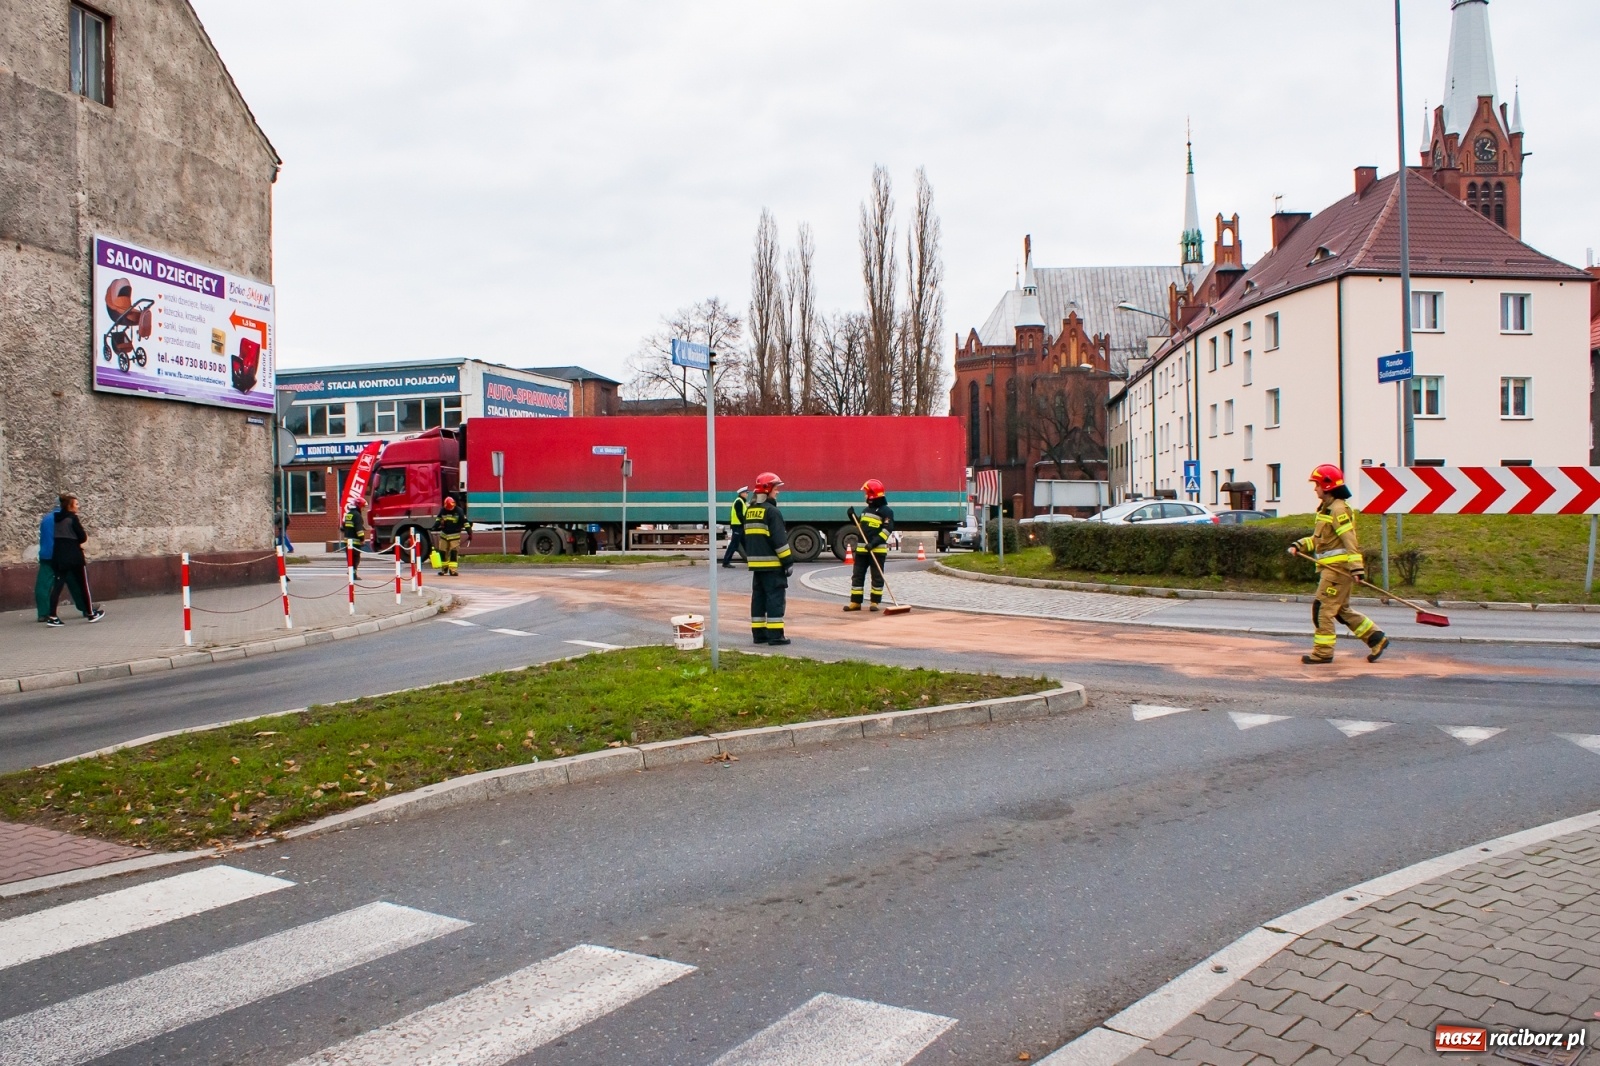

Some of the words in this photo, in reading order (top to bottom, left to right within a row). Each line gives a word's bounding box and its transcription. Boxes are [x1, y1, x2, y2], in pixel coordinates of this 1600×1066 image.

[106, 248, 152, 275] SALON
[157, 262, 218, 293] DZIECIĘCY
[157, 352, 170, 363] tel.
[170, 355, 184, 366] +48
[185, 357, 199, 369] 730
[199, 360, 208, 370] 80
[208, 361, 217, 372] 50
[218, 363, 227, 373] 80
[1385, 359, 1403, 368] Rondo
[1379, 367, 1411, 379] Solidarności
[327, 381, 357, 390] STACJA
[359, 378, 402, 389] KONTROLI
[405, 374, 456, 386] POJAZDÓW
[487, 382, 568, 411] AUTO-SPRAWNOŚĆ
[487, 405, 508, 417] STACJA
[307, 445, 341, 455] KONTROLI
